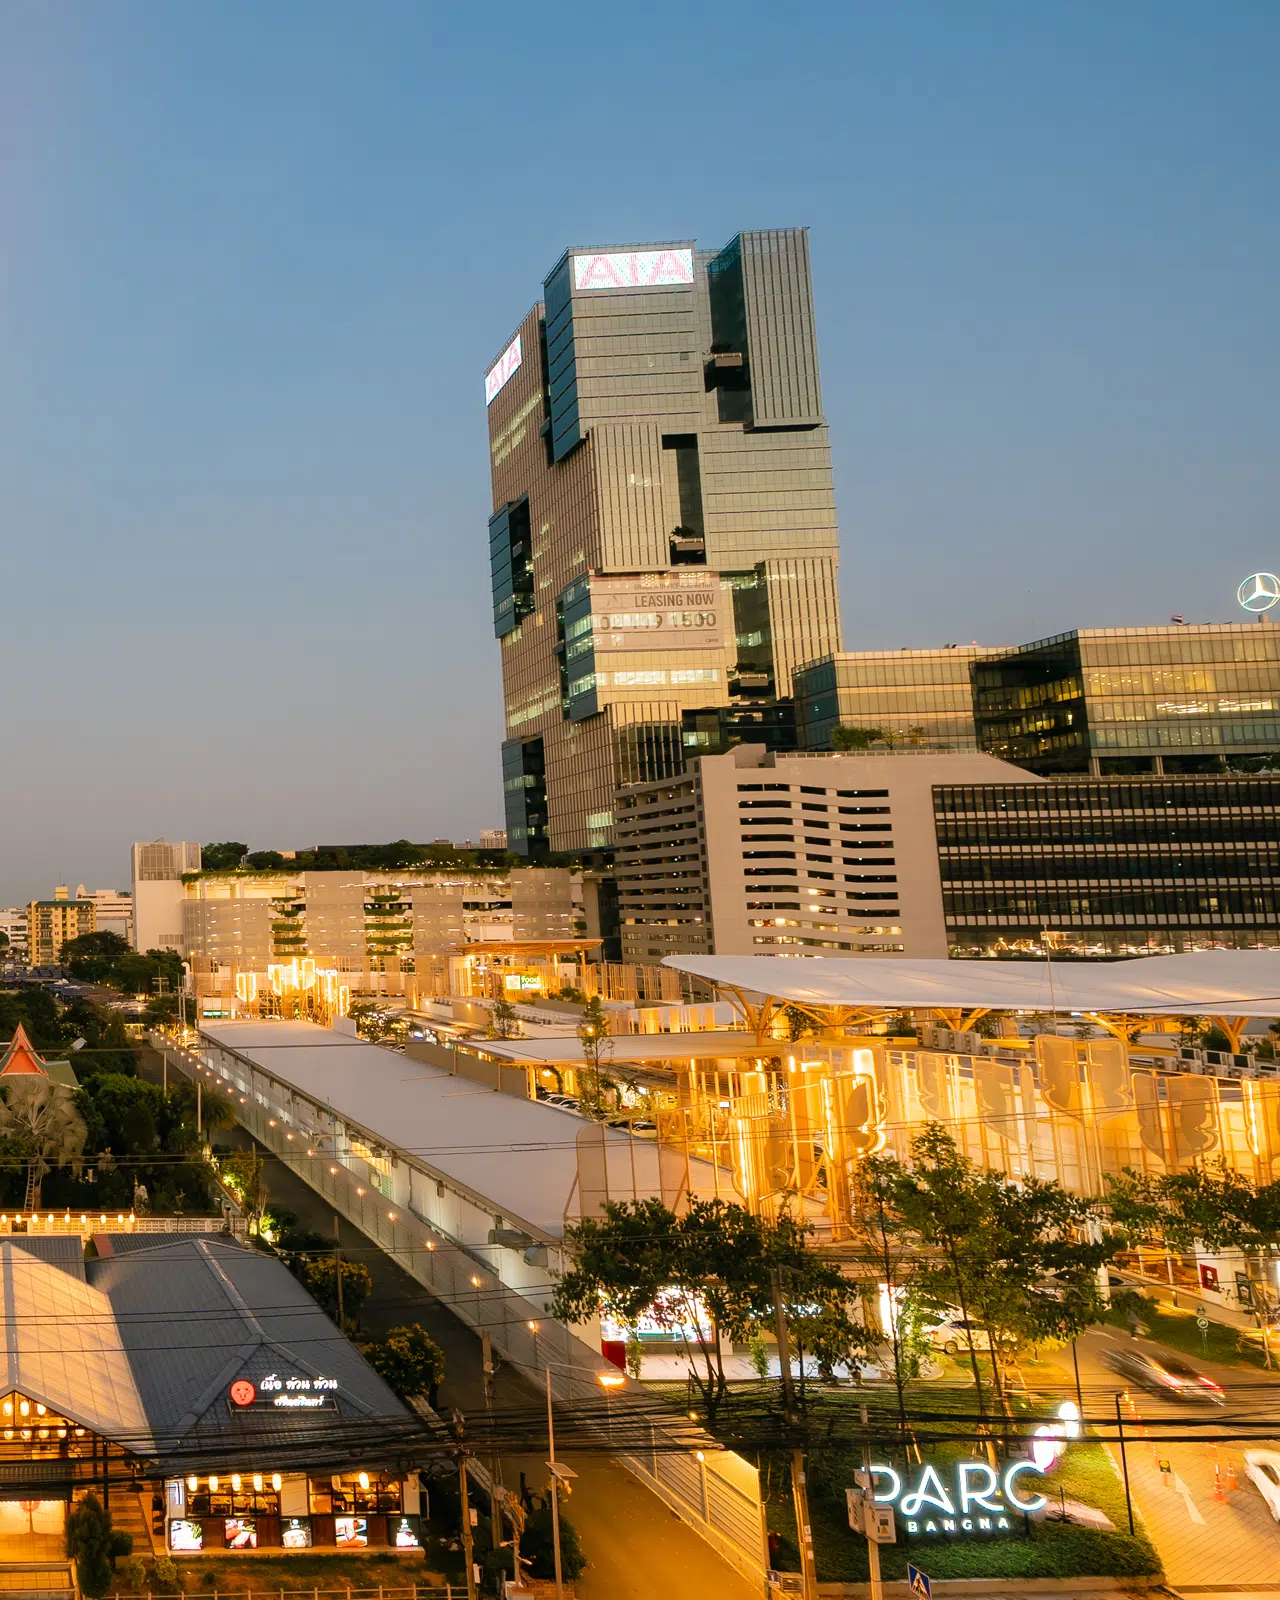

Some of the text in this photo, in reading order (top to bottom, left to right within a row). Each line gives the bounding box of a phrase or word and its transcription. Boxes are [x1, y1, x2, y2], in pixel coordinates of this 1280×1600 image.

[579, 252, 691, 288] AIA
[488, 342, 521, 397] AIA
[634, 593, 715, 608] LEASING NOW
[521, 975, 540, 983] food
[862, 1461, 1047, 1516] PARC
[907, 1517, 1010, 1533] BANGNA
